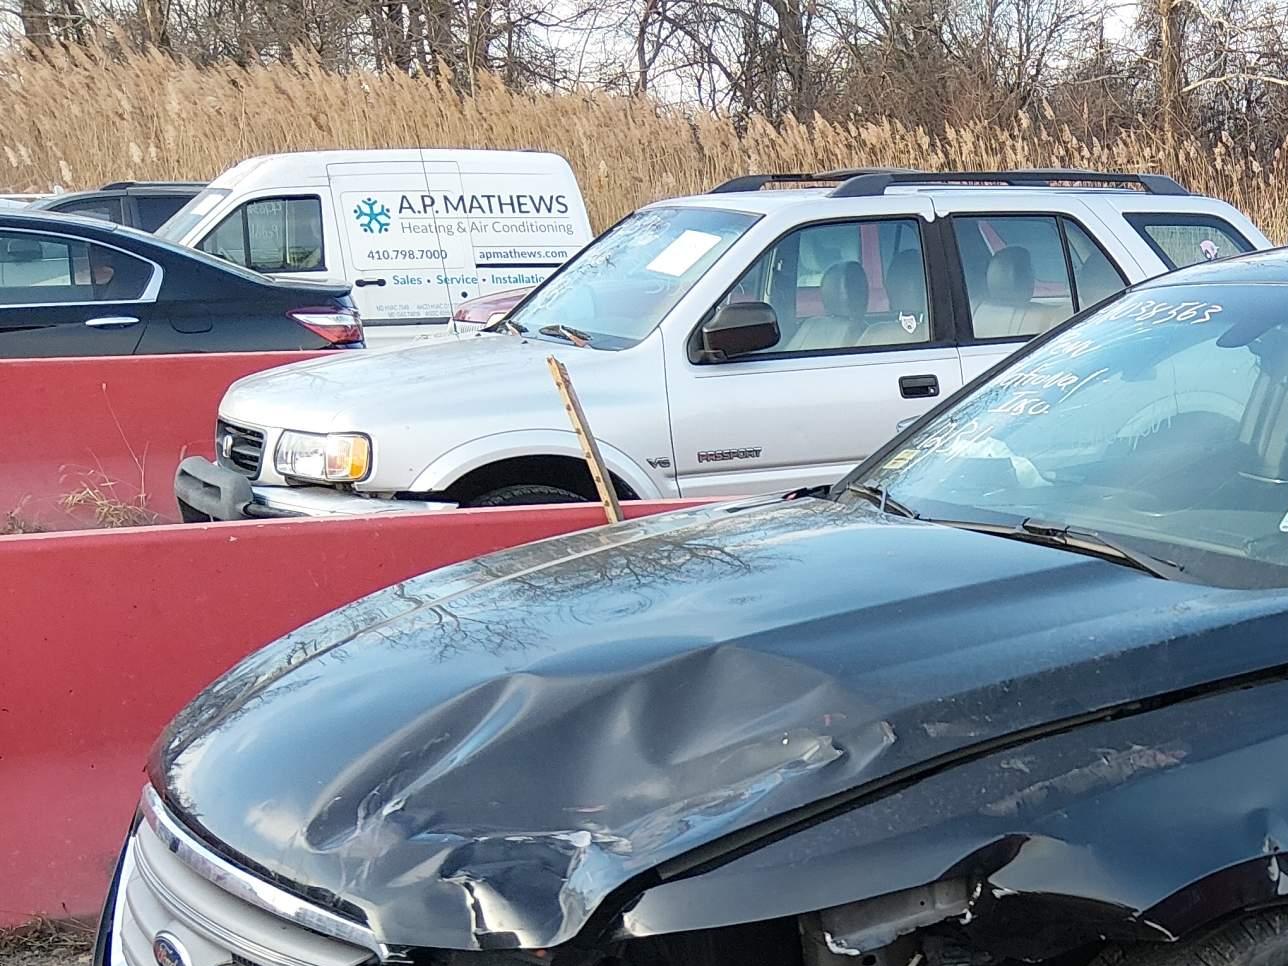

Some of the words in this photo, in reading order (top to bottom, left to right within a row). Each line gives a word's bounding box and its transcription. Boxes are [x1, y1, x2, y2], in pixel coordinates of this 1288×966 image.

[443, 195, 569, 214] MATHEWS
[401, 221, 454, 236] Heating
[456, 221, 467, 233] &
[470, 221, 488, 233] Air
[492, 220, 574, 236] Conditioning
[367, 249, 448, 260] 410.798.7000
[479, 248, 568, 261] apmathews.com
[392, 275, 422, 285] Sales
[436, 274, 478, 285] Service
[697, 447, 763, 463] PASSPORT
[646, 457, 671, 469] V6
